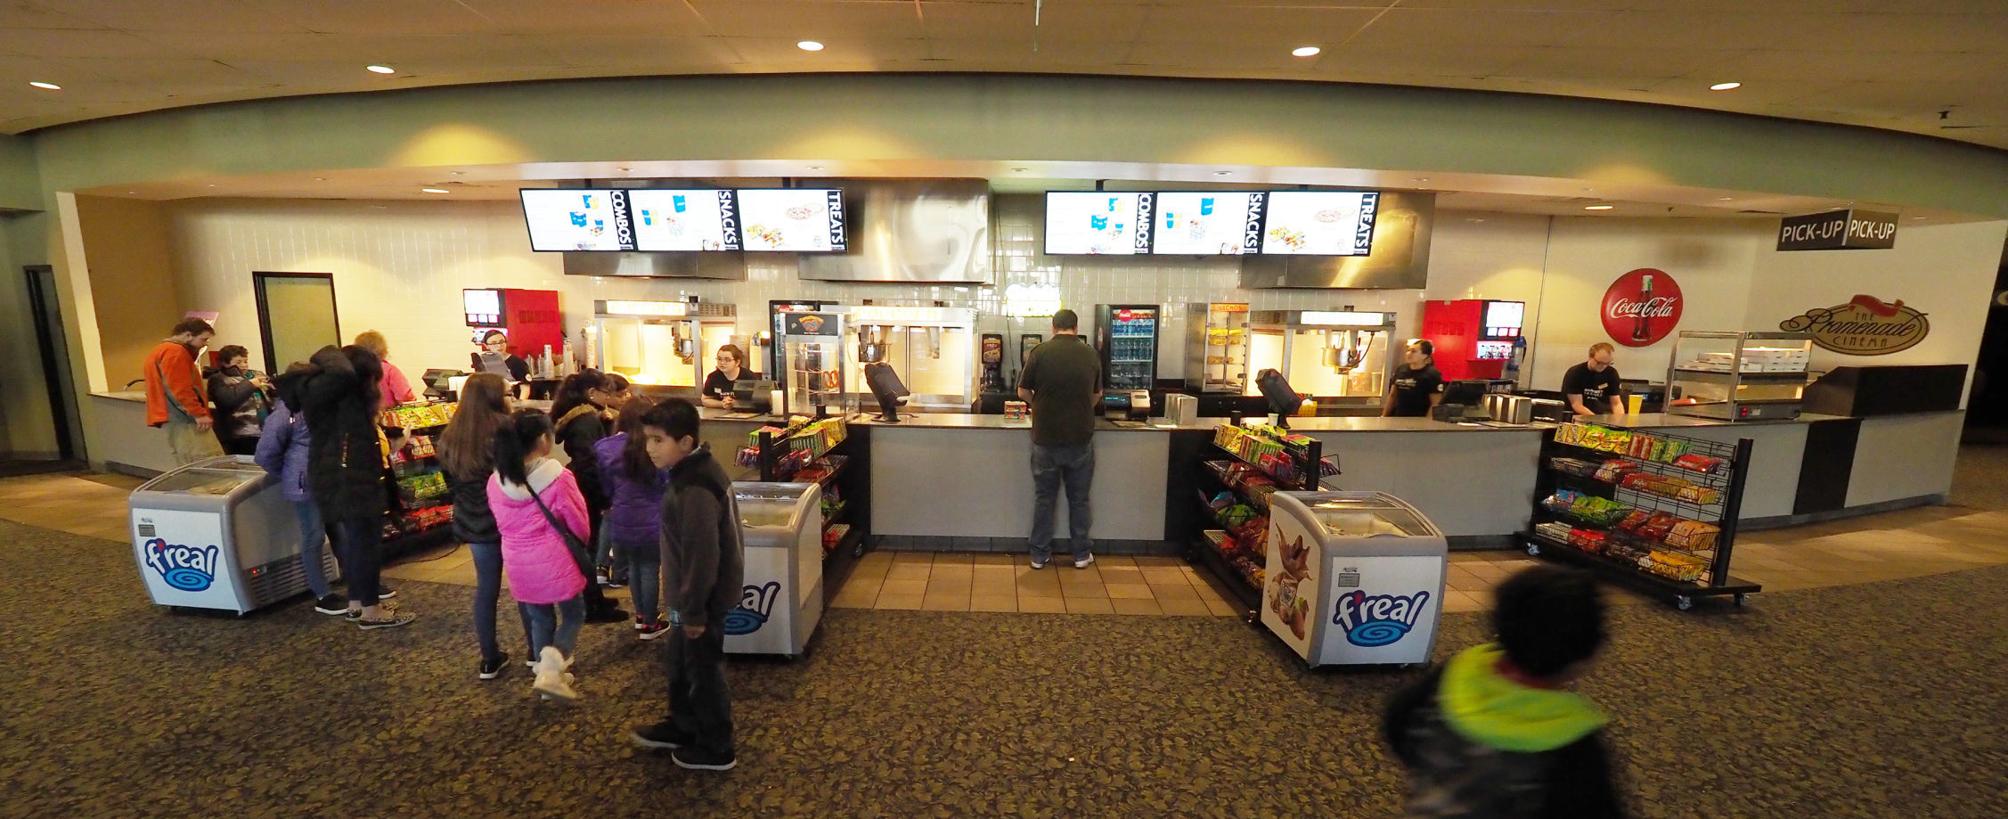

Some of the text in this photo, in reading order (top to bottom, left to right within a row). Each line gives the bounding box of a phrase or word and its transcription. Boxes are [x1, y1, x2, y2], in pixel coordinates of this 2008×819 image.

[611, 190, 632, 244] COMBOS
[719, 191, 737, 244] SNACKS
[828, 192, 845, 244] TREATS
[1136, 193, 1151, 248] COMBOS
[1245, 192, 1262, 247] SNACKS
[1355, 194, 1376, 248] TREATS
[1781, 221, 1843, 242] PICK-UP
[1849, 220, 1895, 239] PICK-UP
[1611, 297, 1678, 318] Coca-Cola
[1780, 308, 1928, 336] Promenade
